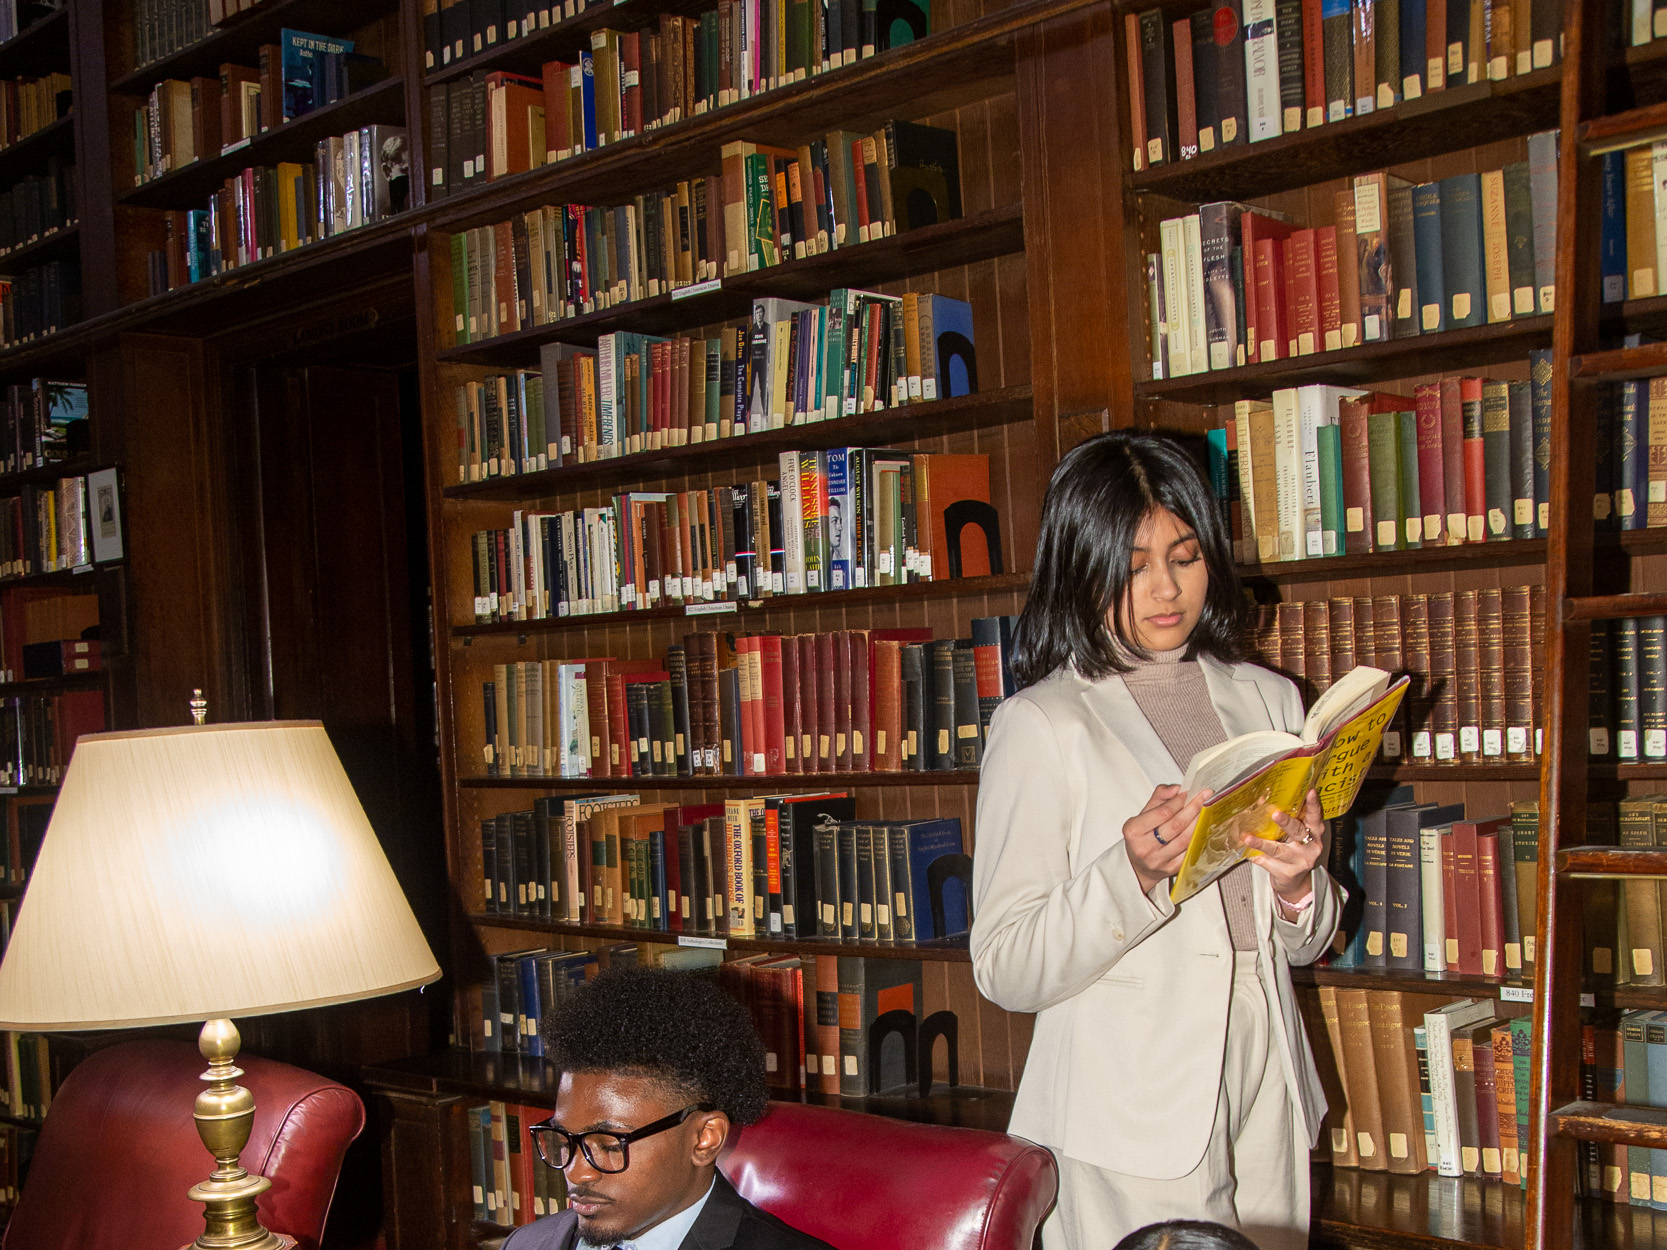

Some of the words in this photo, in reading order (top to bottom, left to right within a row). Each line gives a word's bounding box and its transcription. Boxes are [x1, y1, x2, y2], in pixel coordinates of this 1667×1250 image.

[292, 36, 308, 48] KEPT
[308, 39, 315, 50] IN
[316, 41, 327, 53] THE
[328, 43, 344, 54] DARK
[1490, 176, 1501, 232] SUZANNE
[1203, 254, 1226, 262] FLESH
[1492, 242, 1502, 282] JOSEPH
[1204, 274, 1230, 282] OLETTE
[600, 339, 611, 368] ARTHUR
[737, 364, 745, 374] The
[602, 368, 612, 399] MILLER
[737, 374, 745, 403] Complete
[1536, 388, 1550, 398] The
[602, 400, 614, 446] TIMEBENDS
[736, 404, 744, 422] Plays
[1238, 426, 1248, 446] THE
[828, 454, 844, 462] TOM
[789, 474, 797, 502] O'CLOCK
[1240, 450, 1252, 506] PERPETUAL
[1304, 450, 1317, 505] Flaubert
[801, 459, 812, 528] WILLIAMS
[809, 456, 820, 528] TENNESSEE
[1244, 510, 1254, 542] ORGY
[1333, 732, 1358, 750] ow
[1368, 712, 1387, 731] to
[1321, 759, 1353, 782] ith
[1362, 750, 1372, 762] a
[1326, 738, 1370, 768] rgue
[748, 808, 760, 817] THE
[566, 815, 576, 859] FOOTSTEPS
[734, 839, 743, 864] OXFORD
[738, 890, 744, 904] OF
[1348, 1000, 1368, 1010] Essays
[1380, 1003, 1402, 1012] Essays
[1506, 989, 1518, 998] 840
[1372, 1020, 1402, 1030] Montaigne
